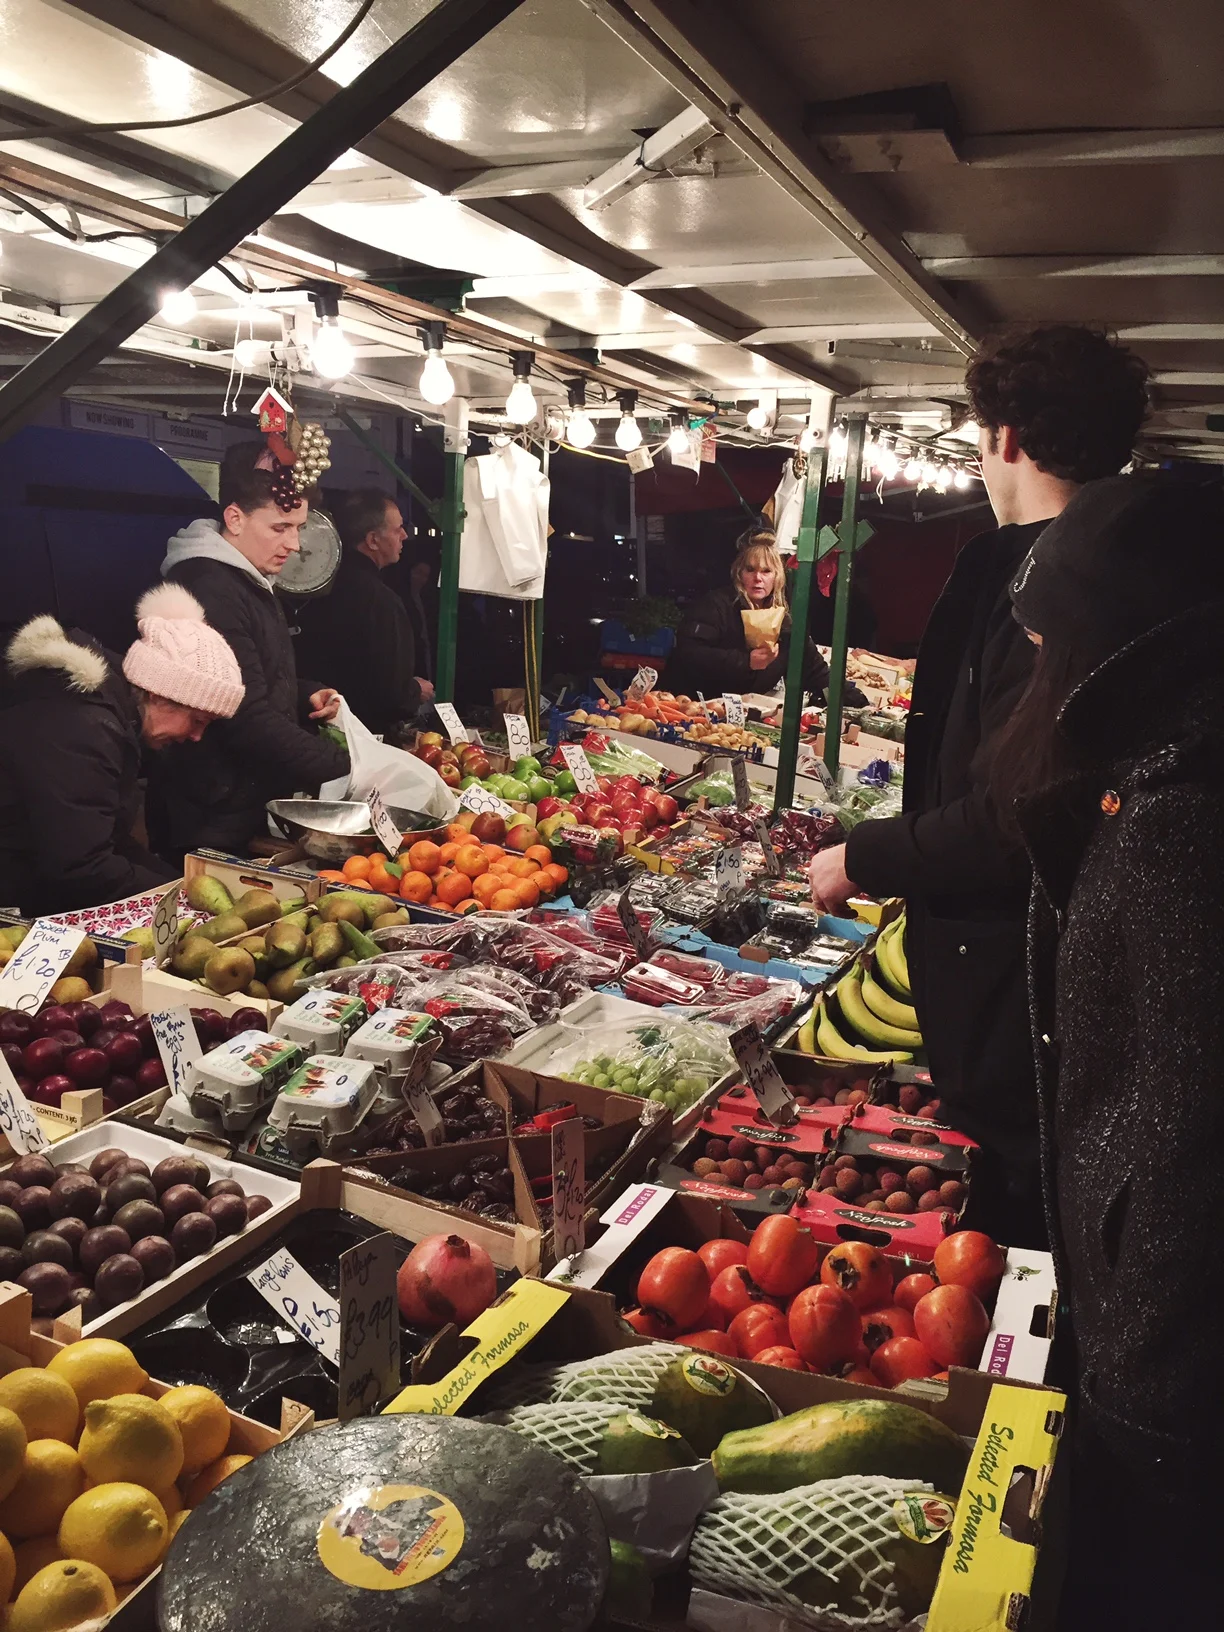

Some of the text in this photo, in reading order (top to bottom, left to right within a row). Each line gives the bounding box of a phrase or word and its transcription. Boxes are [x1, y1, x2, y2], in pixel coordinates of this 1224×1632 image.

[102, 414, 135, 429] SHOWING
[510, 723, 529, 746] 80
[716, 850, 740, 878] £1.50
[35, 920, 72, 935] Sweet
[155, 908, 178, 945] 80
[2, 943, 56, 981] £1.20
[618, 1189, 655, 1224] Del Rodat
[839, 1210, 909, 1228] Neofresh
[252, 1268, 281, 1292] Large
[282, 1297, 341, 1349] £1.50
[343, 1296, 394, 1369] £3.99
[470, 1320, 530, 1370] Formosa
[996, 1336, 1011, 1353] Del
[953, 1421, 1014, 1575] Selected Formosa
